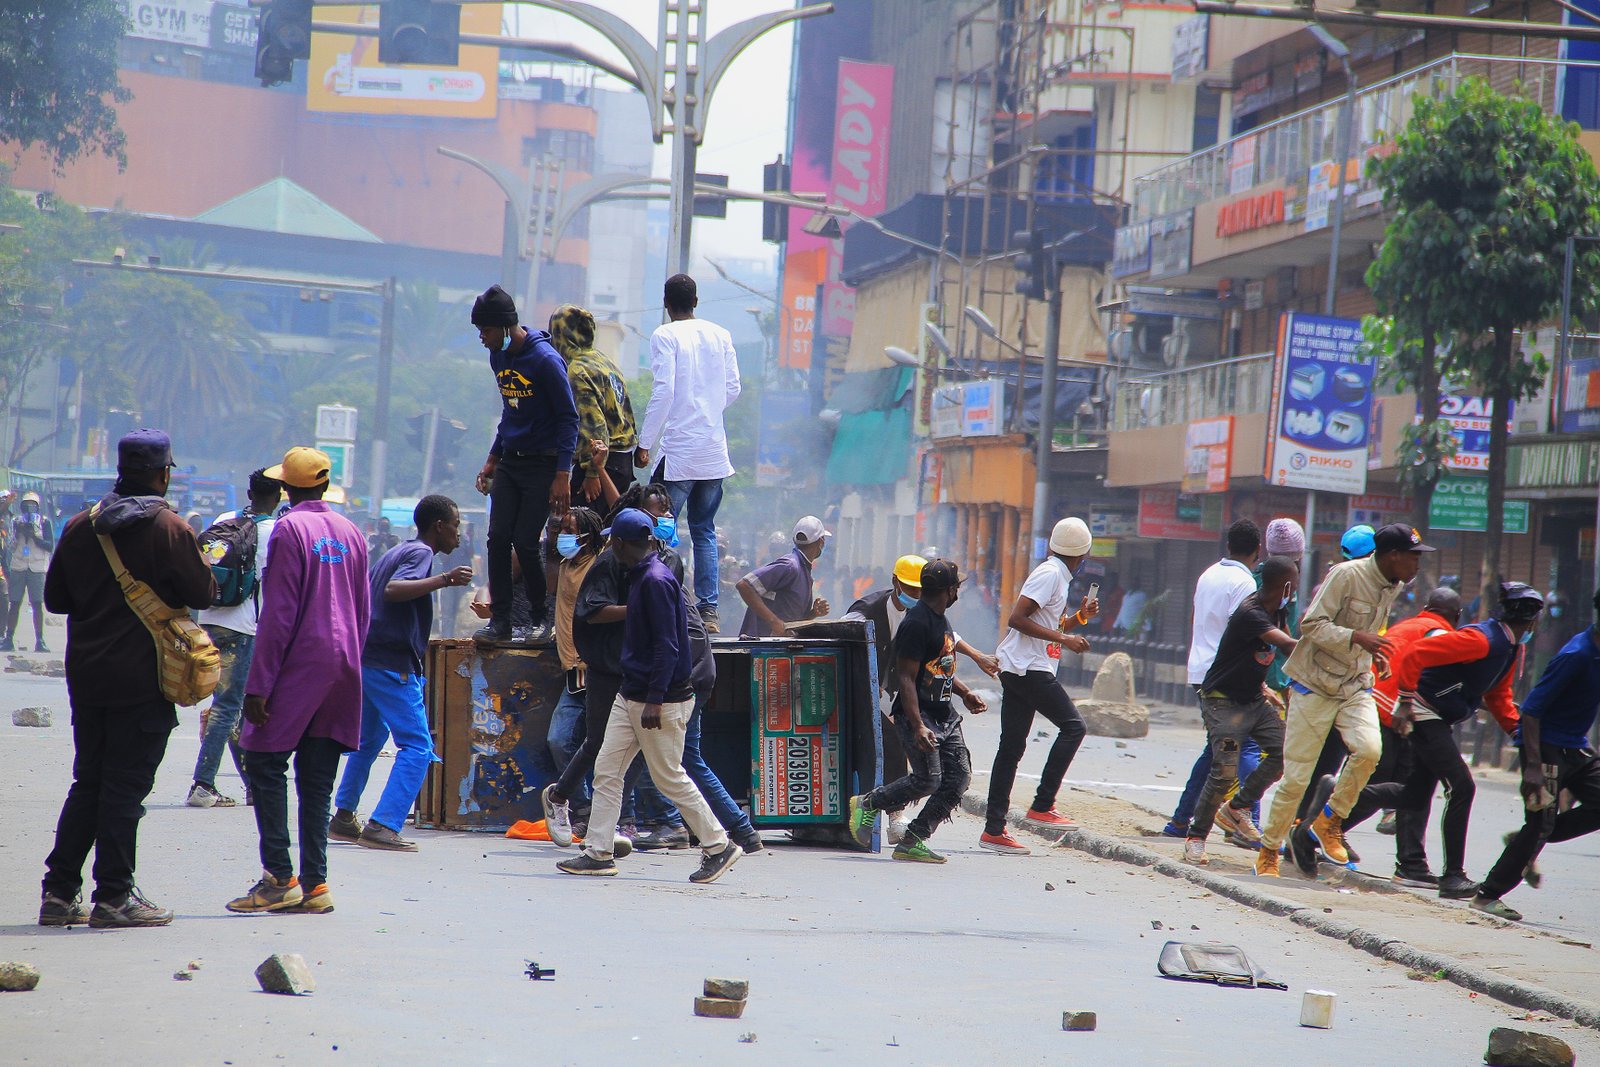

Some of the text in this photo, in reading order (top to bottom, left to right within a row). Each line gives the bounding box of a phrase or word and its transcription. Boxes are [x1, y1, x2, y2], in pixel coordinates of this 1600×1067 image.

[137, 5, 186, 32] GYM
[1292, 336, 1307, 346] FOR
[1307, 337, 1338, 350] THERMAL
[1294, 322, 1315, 335] YOUR
[1315, 324, 1332, 338] ONE
[1332, 326, 1354, 340] STOP
[1309, 456, 1353, 468] RIKKO
[1519, 440, 1582, 486] DOMINION
[769, 664, 778, 725] LINES AVAILABLE
[788, 737, 809, 815] 2039603
